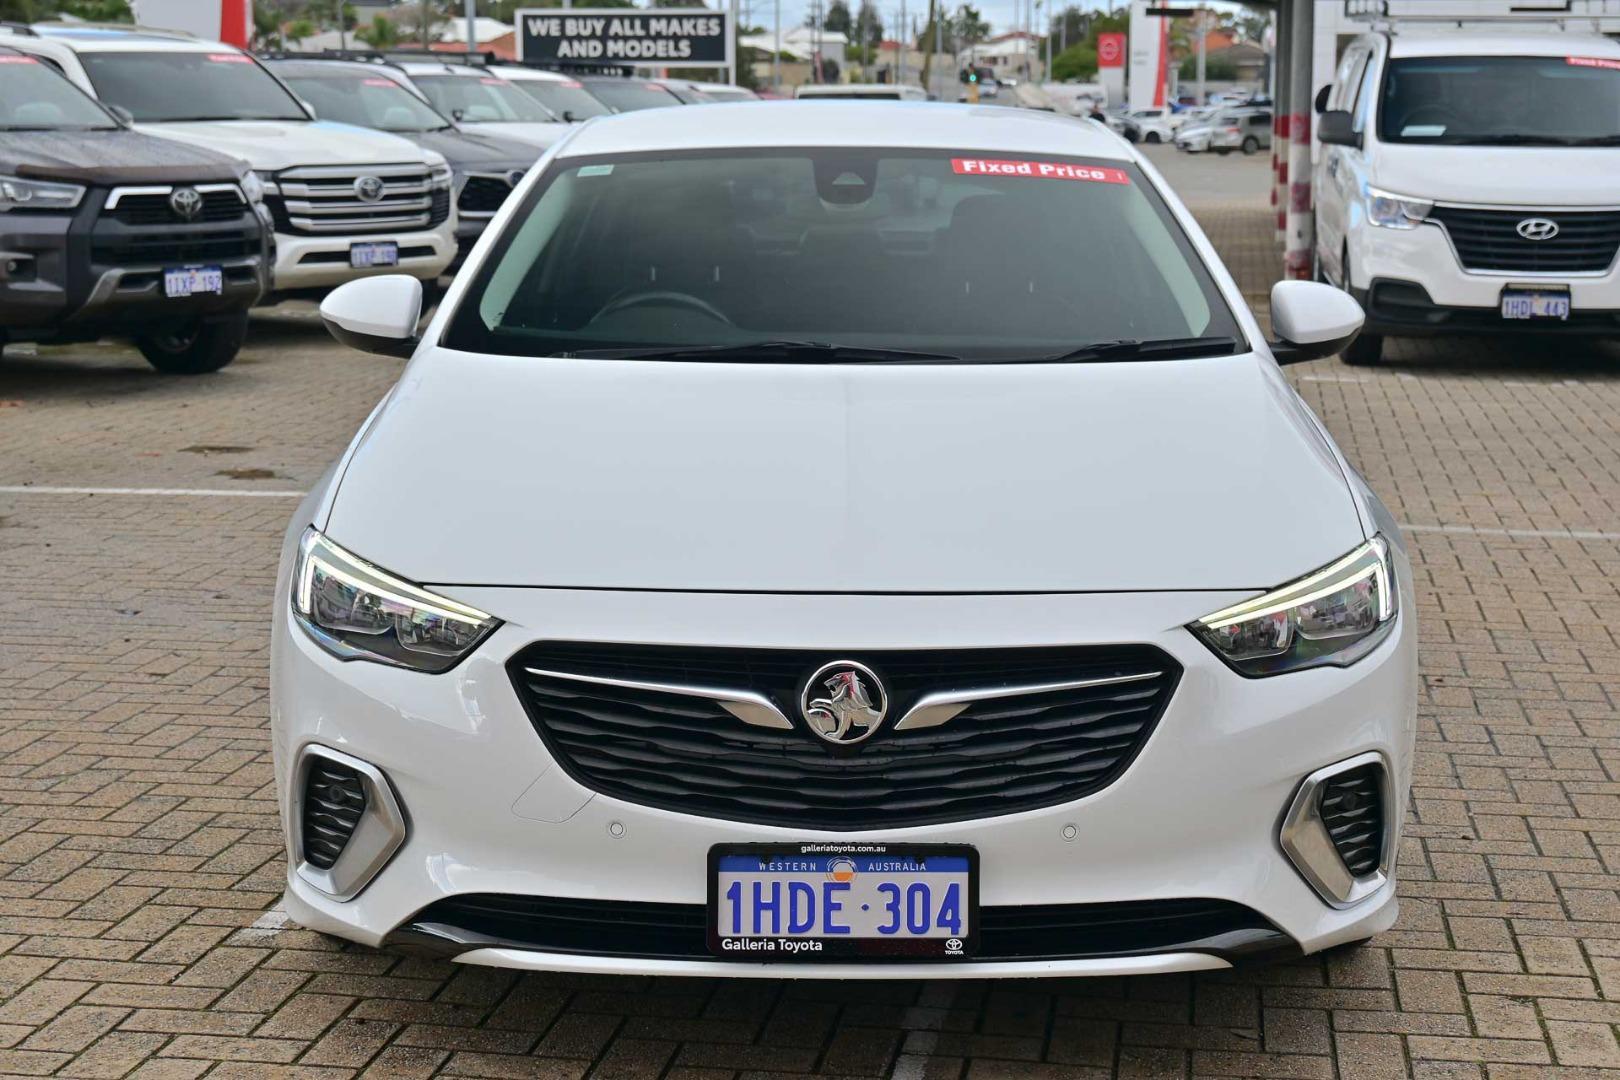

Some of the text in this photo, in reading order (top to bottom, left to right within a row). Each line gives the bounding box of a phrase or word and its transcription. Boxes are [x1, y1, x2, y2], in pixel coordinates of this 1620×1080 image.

[527, 17, 721, 37] WE BUY ALL MAKES
[557, 39, 691, 58] AND MODELS
[962, 160, 1105, 180] Fixed Price
[801, 844, 886, 853] galleriatoyota.com.au
[758, 862, 927, 871] WESTERN AUSTRALIA
[721, 938, 823, 954] Galleria Toyota
